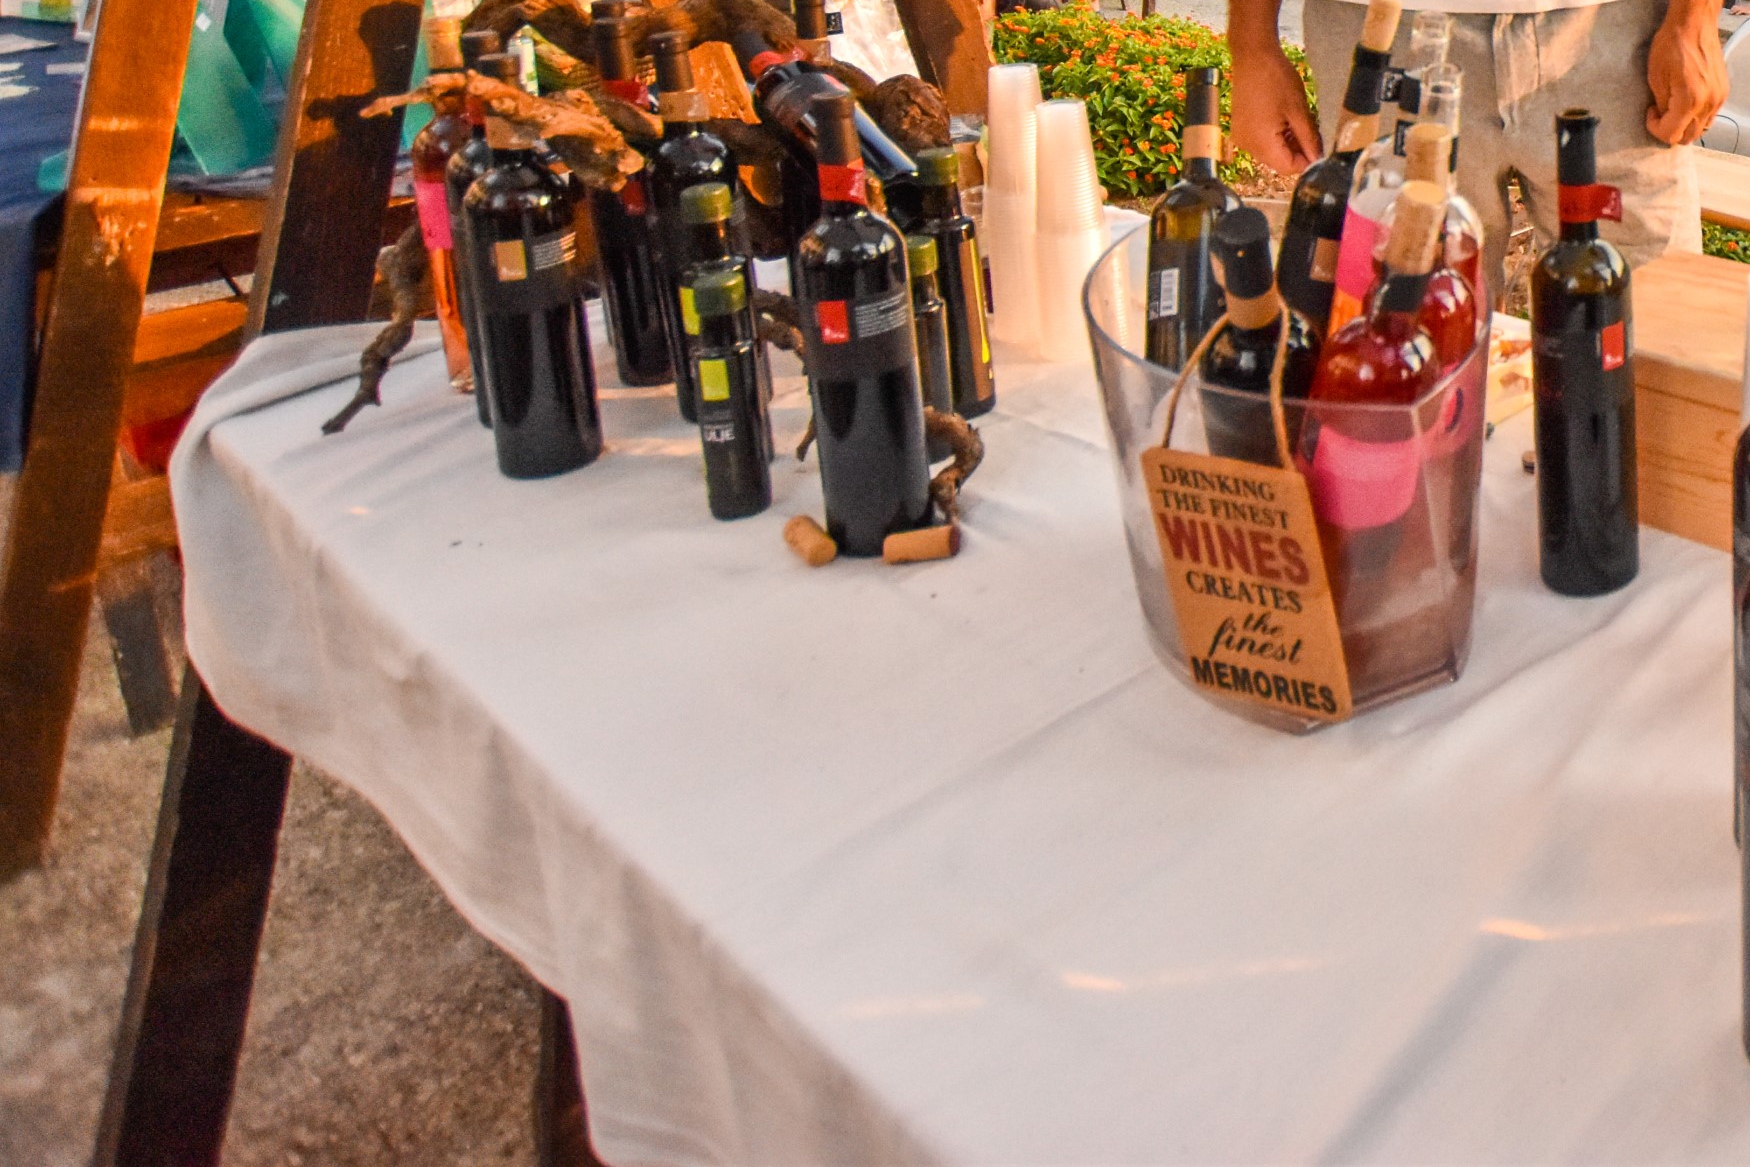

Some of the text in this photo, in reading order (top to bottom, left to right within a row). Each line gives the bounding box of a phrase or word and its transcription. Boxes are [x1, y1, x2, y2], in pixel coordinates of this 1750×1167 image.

[1160, 465, 1275, 501] DRINKING
[1157, 489, 1288, 530] THE FINEST
[1158, 512, 1310, 586] WINES
[1186, 570, 1303, 613] CREATES
[1208, 617, 1302, 664] finest
[1243, 611, 1283, 636] the
[1192, 656, 1337, 714] MEMORIES
